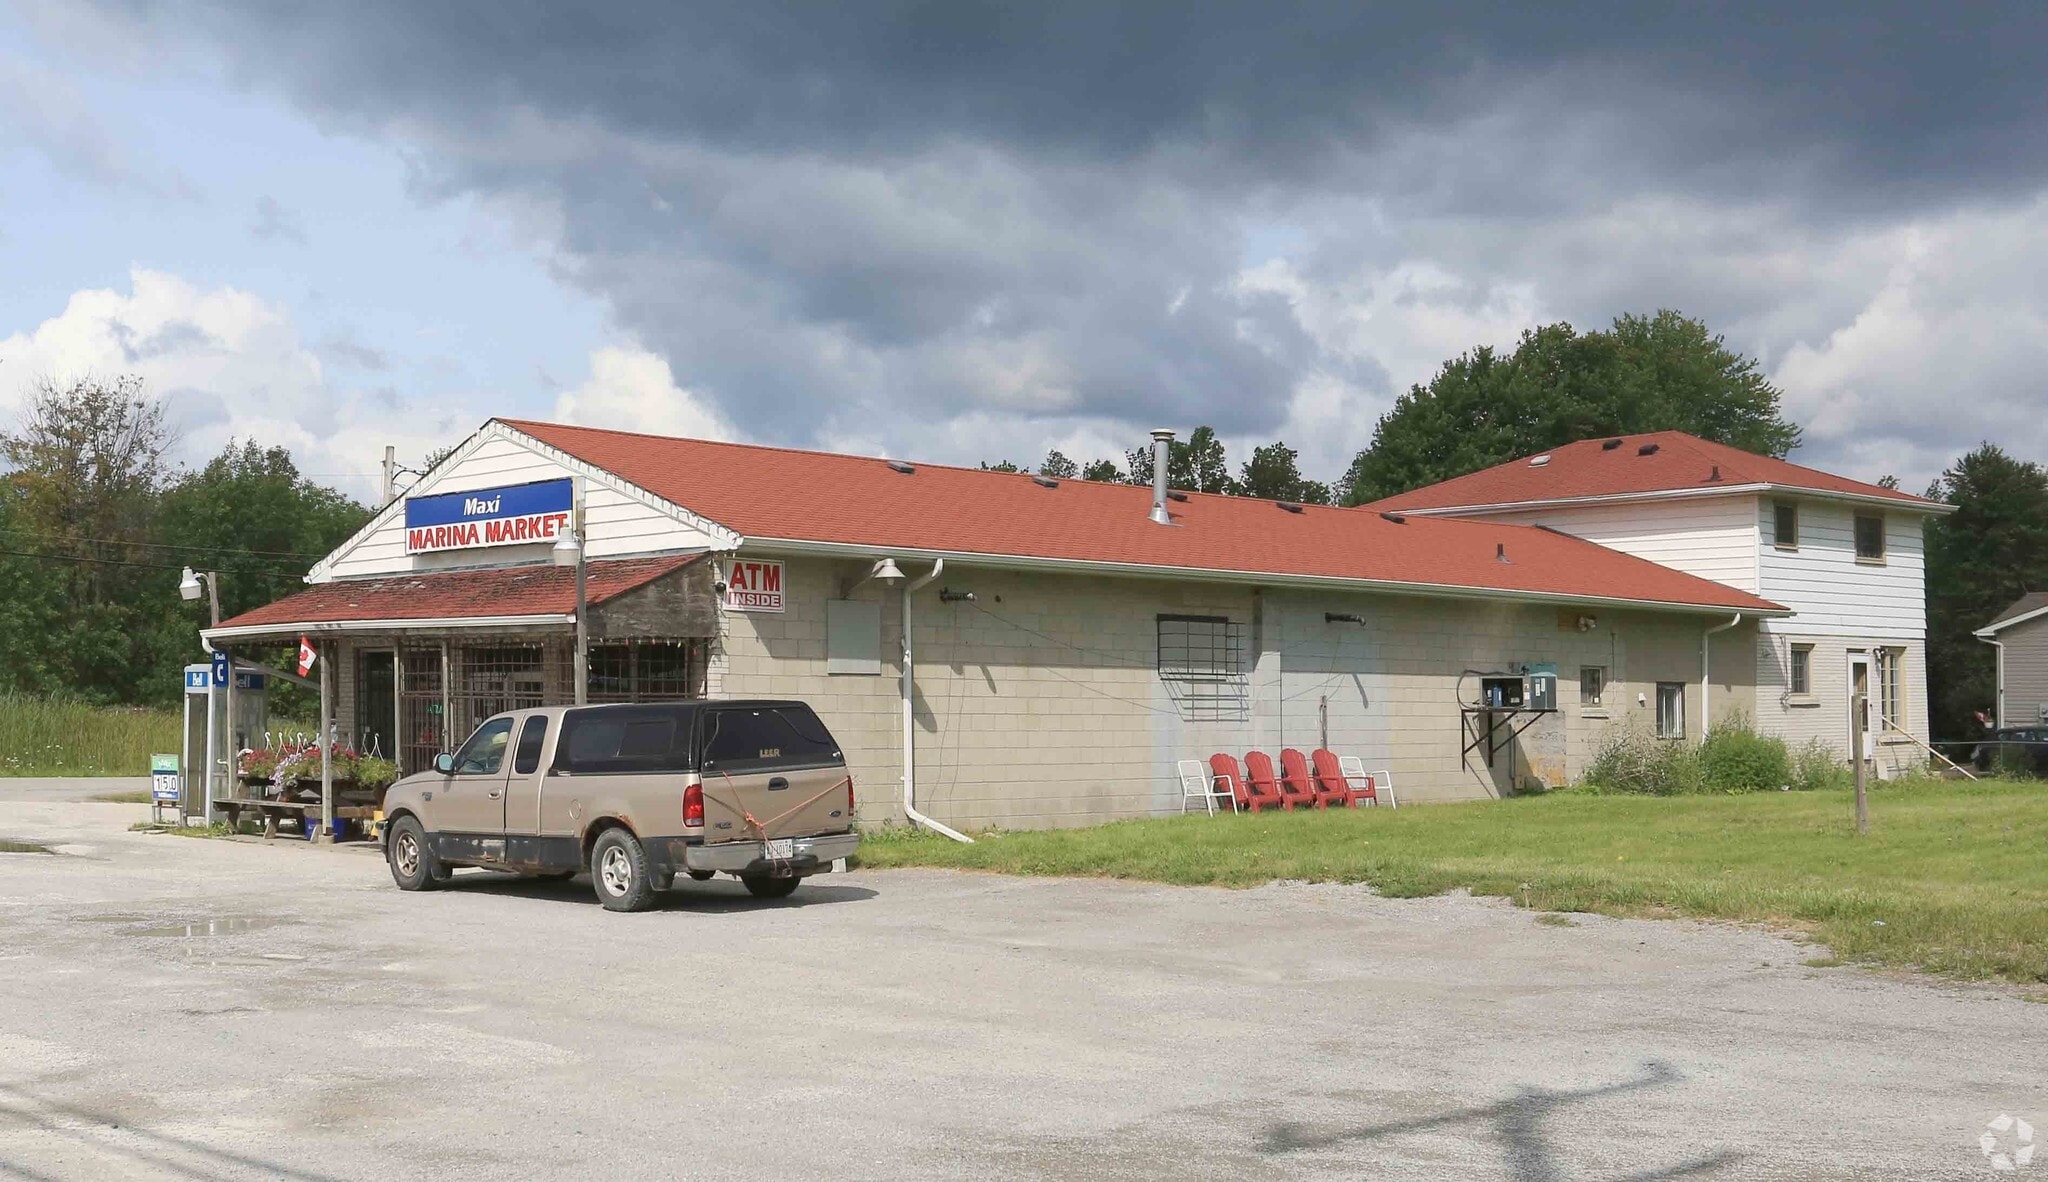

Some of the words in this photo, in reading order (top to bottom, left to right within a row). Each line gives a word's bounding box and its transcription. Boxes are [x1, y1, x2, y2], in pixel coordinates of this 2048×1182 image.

[463, 495, 501, 516] Maxi
[409, 523, 479, 550] MARINA
[485, 513, 568, 544] MARKET
[729, 562, 780, 592] ATM
[730, 592, 780, 607] INSIDE
[214, 653, 226, 661] Bell
[192, 672, 203, 686] Bell
[760, 748, 781, 758] LEER
